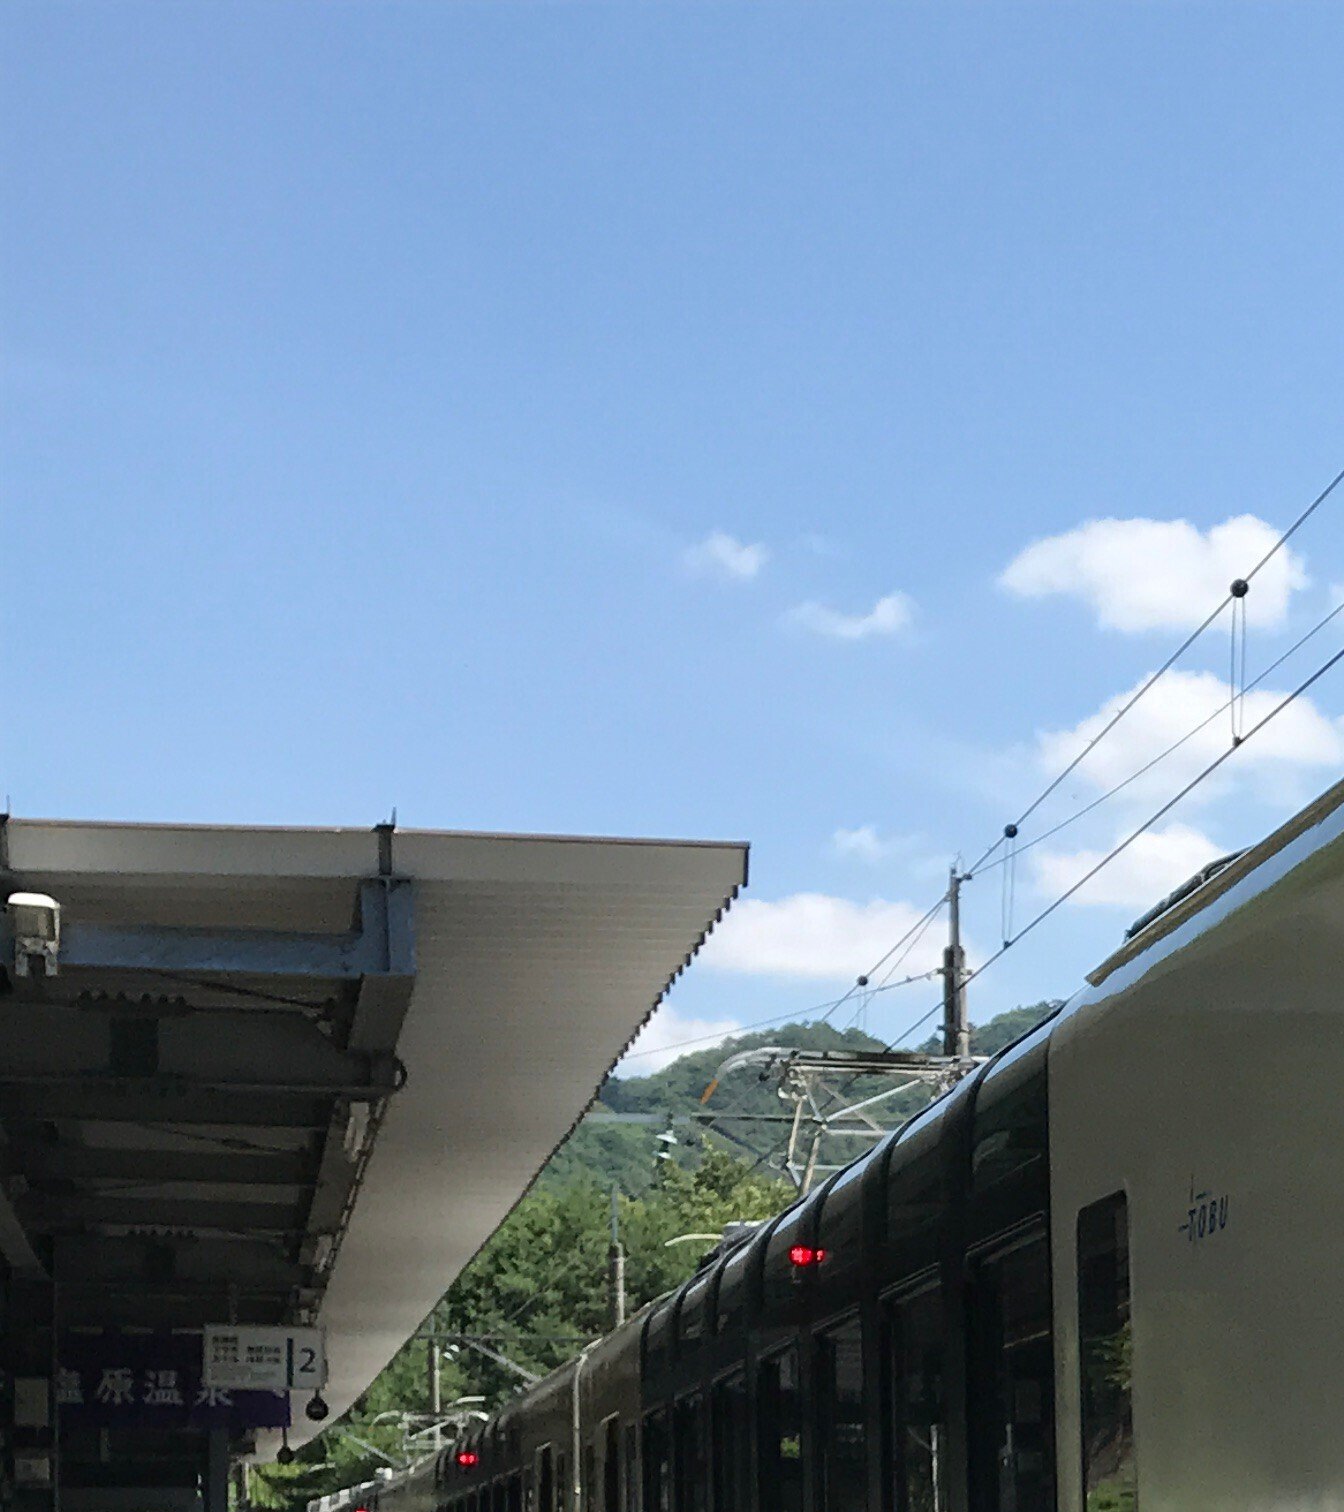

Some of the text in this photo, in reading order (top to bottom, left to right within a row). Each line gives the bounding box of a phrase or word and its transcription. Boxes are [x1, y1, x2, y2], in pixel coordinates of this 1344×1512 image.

[1188, 1194, 1229, 1242] TOBU
[299, 1346, 316, 1373] 2
[55, 1366, 286, 1407] 塩原温泉
